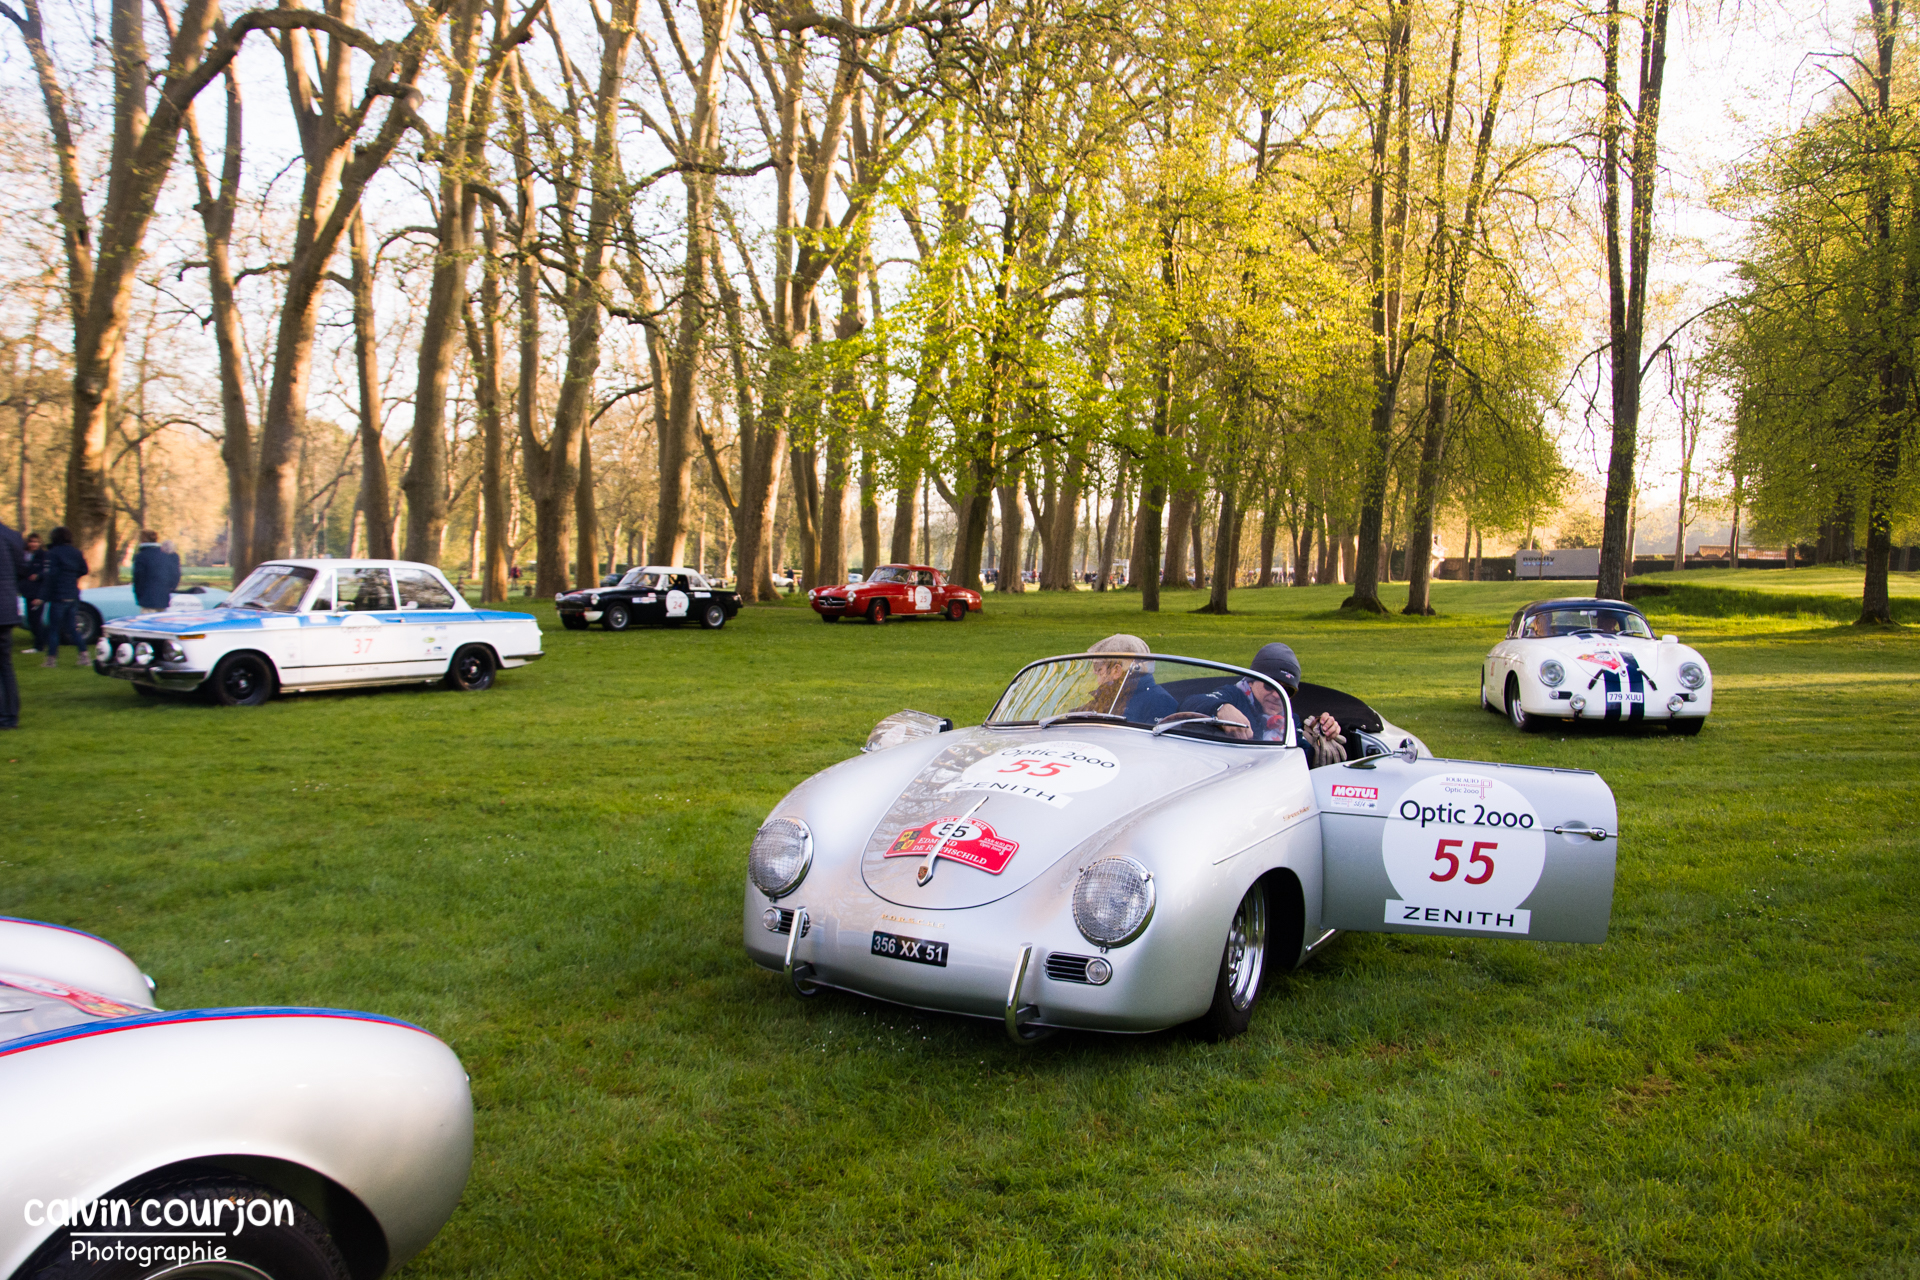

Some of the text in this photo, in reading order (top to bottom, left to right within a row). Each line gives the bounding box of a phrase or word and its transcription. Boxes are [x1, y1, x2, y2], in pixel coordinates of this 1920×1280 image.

[353, 638, 374, 654] 37
[1609, 693, 1641, 701] 779 XUU
[1001, 748, 1115, 769] Optic 2000
[997, 759, 1072, 777] 55
[955, 781, 1056, 801] ZENITH
[1333, 786, 1376, 798] MOTUL
[1445, 786, 1462, 794] Optic
[1400, 800, 1534, 829] Optic 2000
[938, 823, 970, 838] 55
[917, 837, 958, 847] EDMND
[925, 844, 987, 864] RTHSCHILD
[1429, 839, 1498, 885] 55
[881, 913, 945, 929] PORSCHE
[1403, 906, 1514, 927] ZENITH
[873, 936, 943, 962] 356 XX 51
